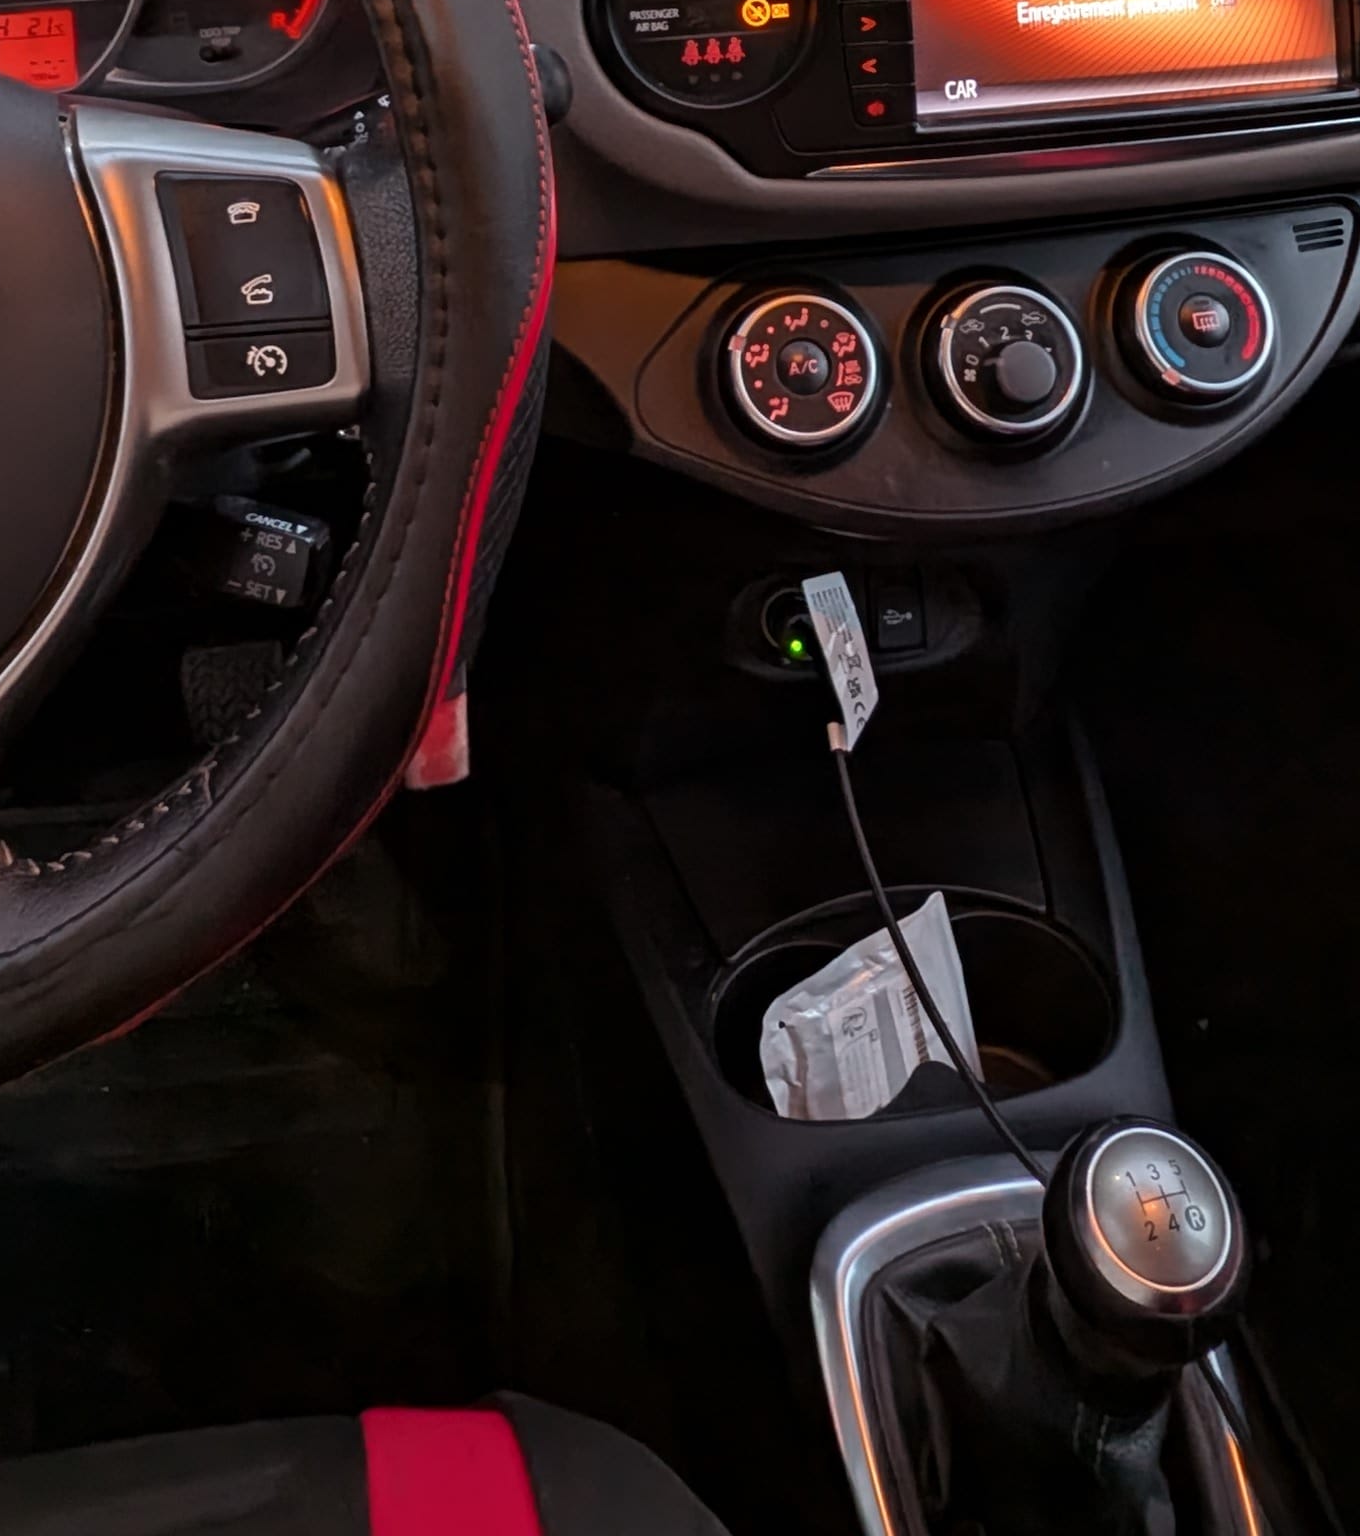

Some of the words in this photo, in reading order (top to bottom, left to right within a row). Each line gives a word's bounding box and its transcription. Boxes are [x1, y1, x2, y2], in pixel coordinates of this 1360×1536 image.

[629, 8, 680, 21] PASSENGER
[945, 79, 978, 101] CAR
[1000, 327, 1010, 340] 2
[789, 359, 818, 376] A/C
[245, 512, 293, 532] CANCEL
[256, 531, 283, 550] RES
[244, 579, 272, 600] SET
[1146, 1163, 1160, 1181] 3
[1168, 1159, 1181, 1176] 5
[1125, 1170, 1136, 1187] 1
[1168, 1213, 1180, 1232] 4
[1187, 1207, 1205, 1231] R
[1144, 1220, 1158, 1242] 2
